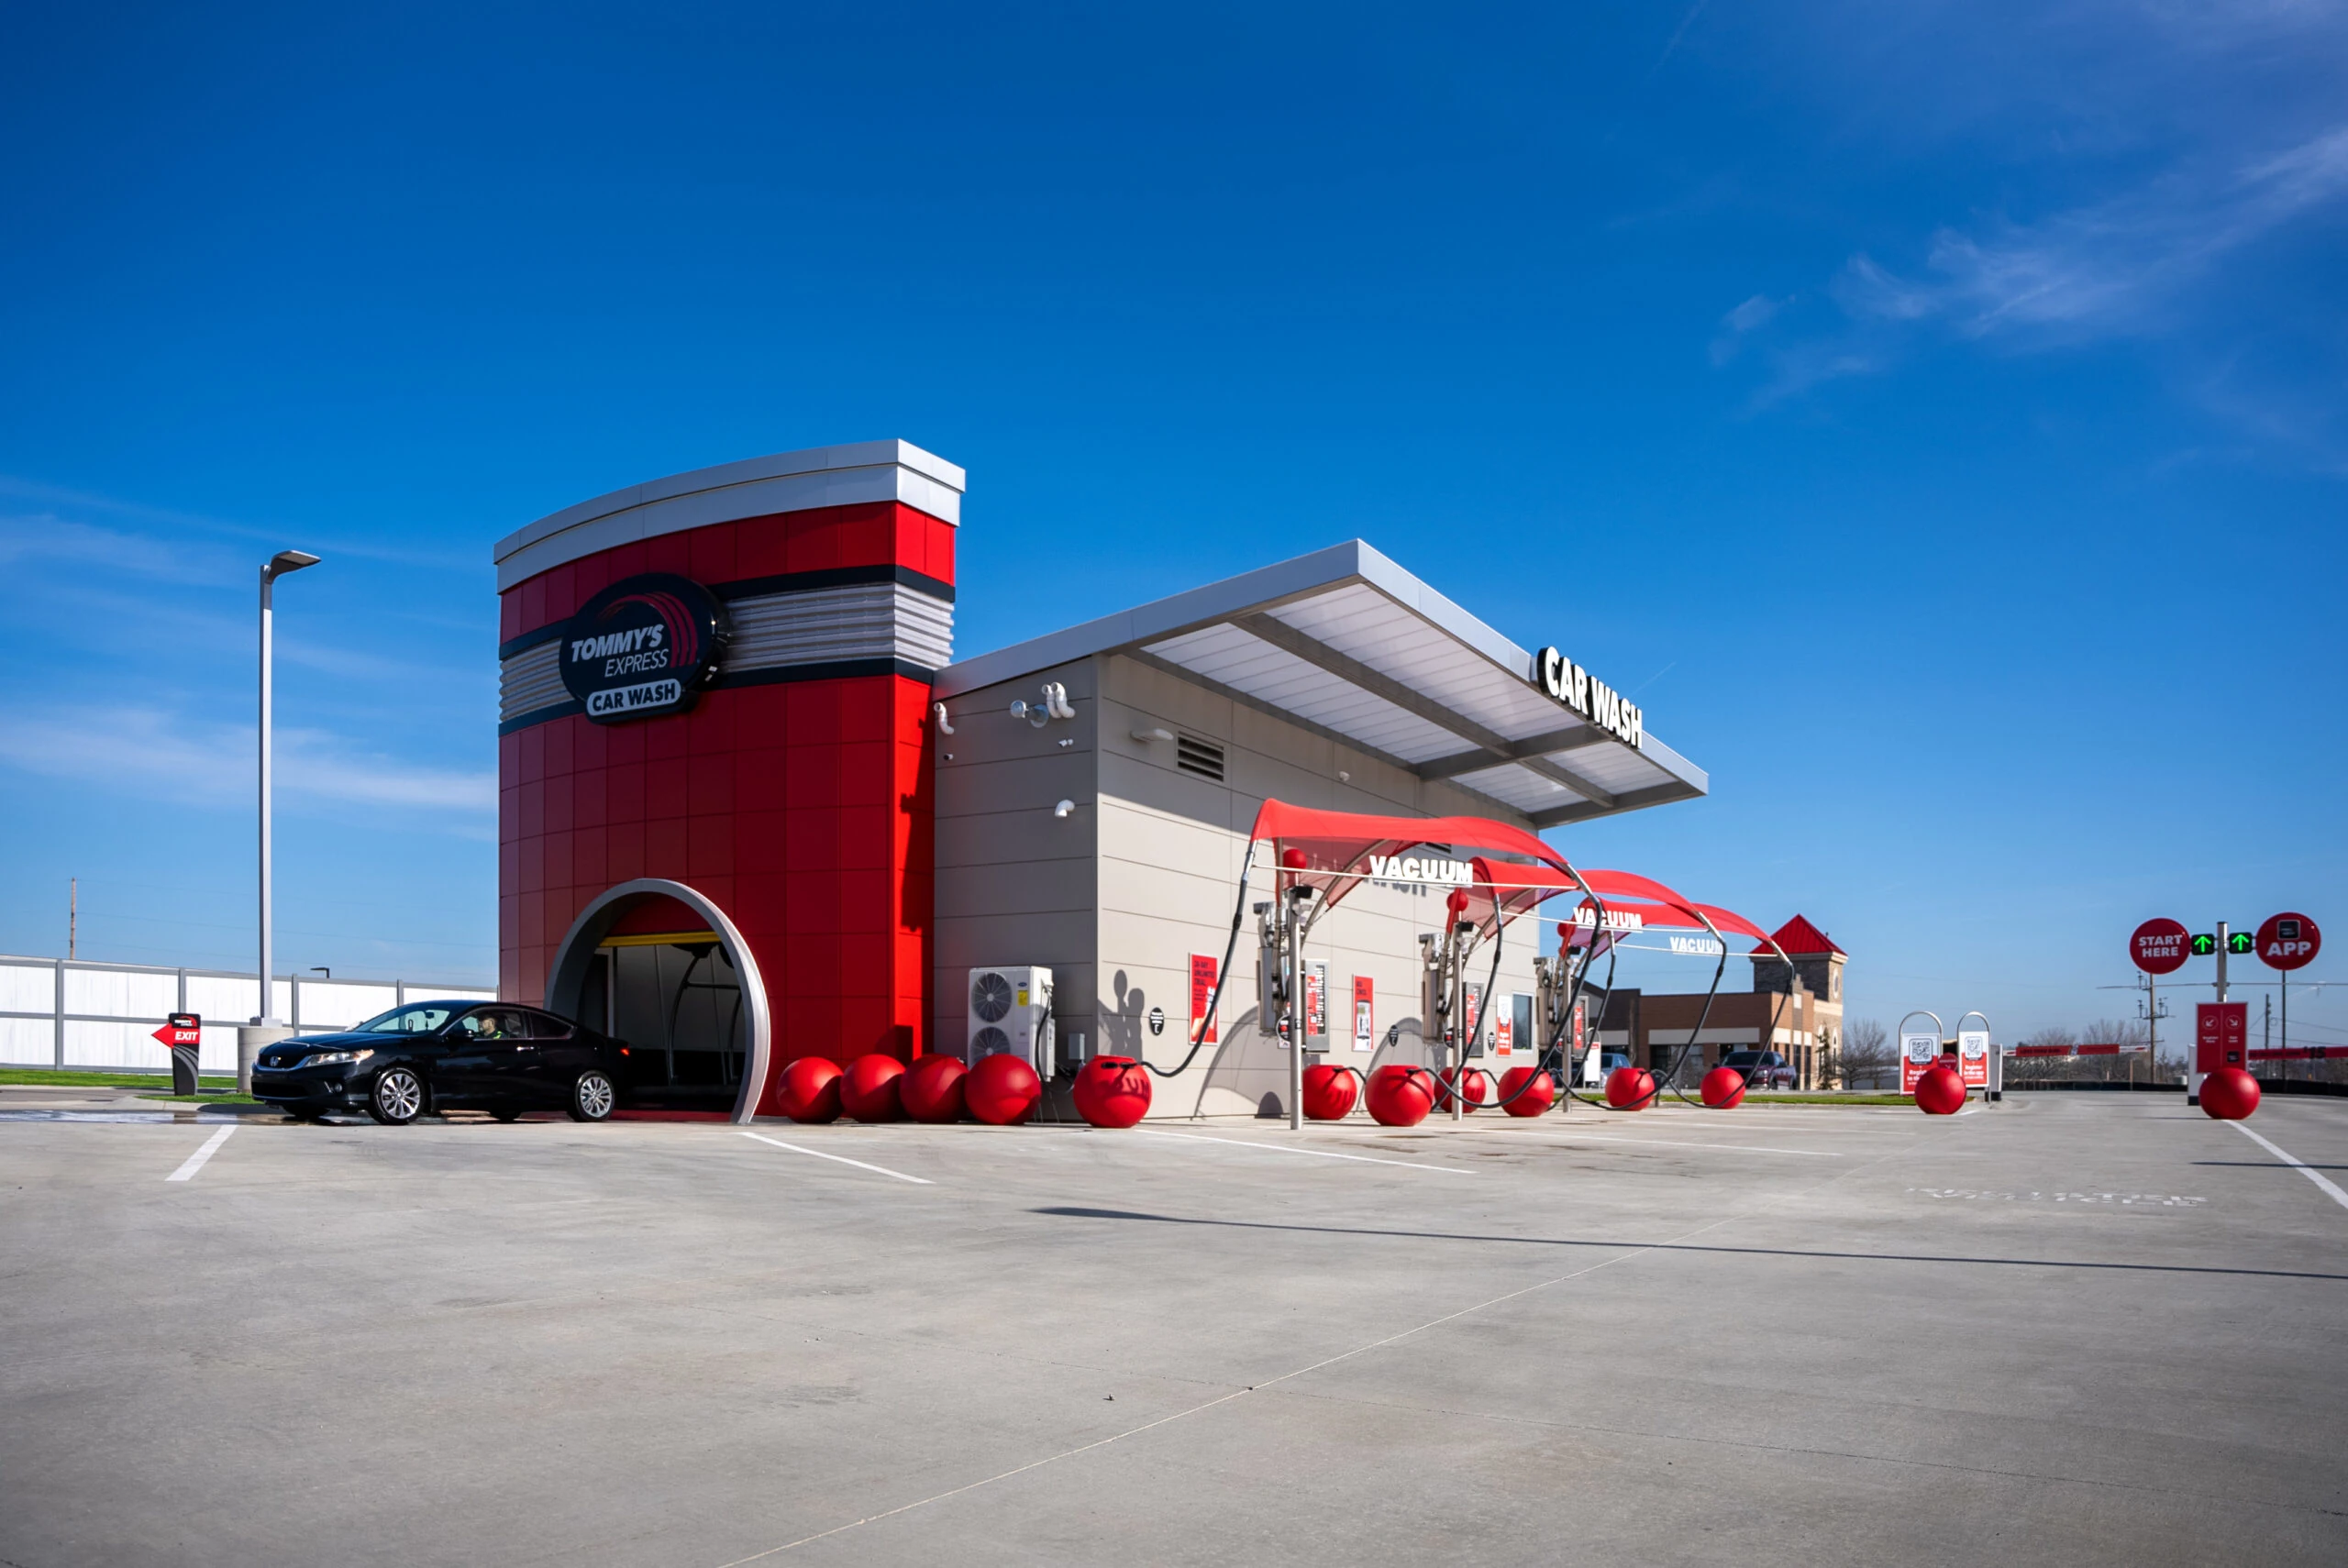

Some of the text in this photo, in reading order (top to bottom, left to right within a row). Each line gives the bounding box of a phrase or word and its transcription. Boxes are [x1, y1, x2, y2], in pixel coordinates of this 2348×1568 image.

[571, 624, 664, 662] TOMMY'S
[604, 648, 669, 678] EXPRESS
[593, 682, 676, 712] CAR WASH
[1542, 646, 1643, 749] CAR WASH
[1369, 856, 1473, 885] VACUUM
[1670, 936, 1723, 954] VACUUM
[2139, 933, 2183, 947] START
[2266, 941, 2311, 956] APP
[2142, 947, 2179, 958] HERE
[175, 1031, 198, 1042] EXIT
